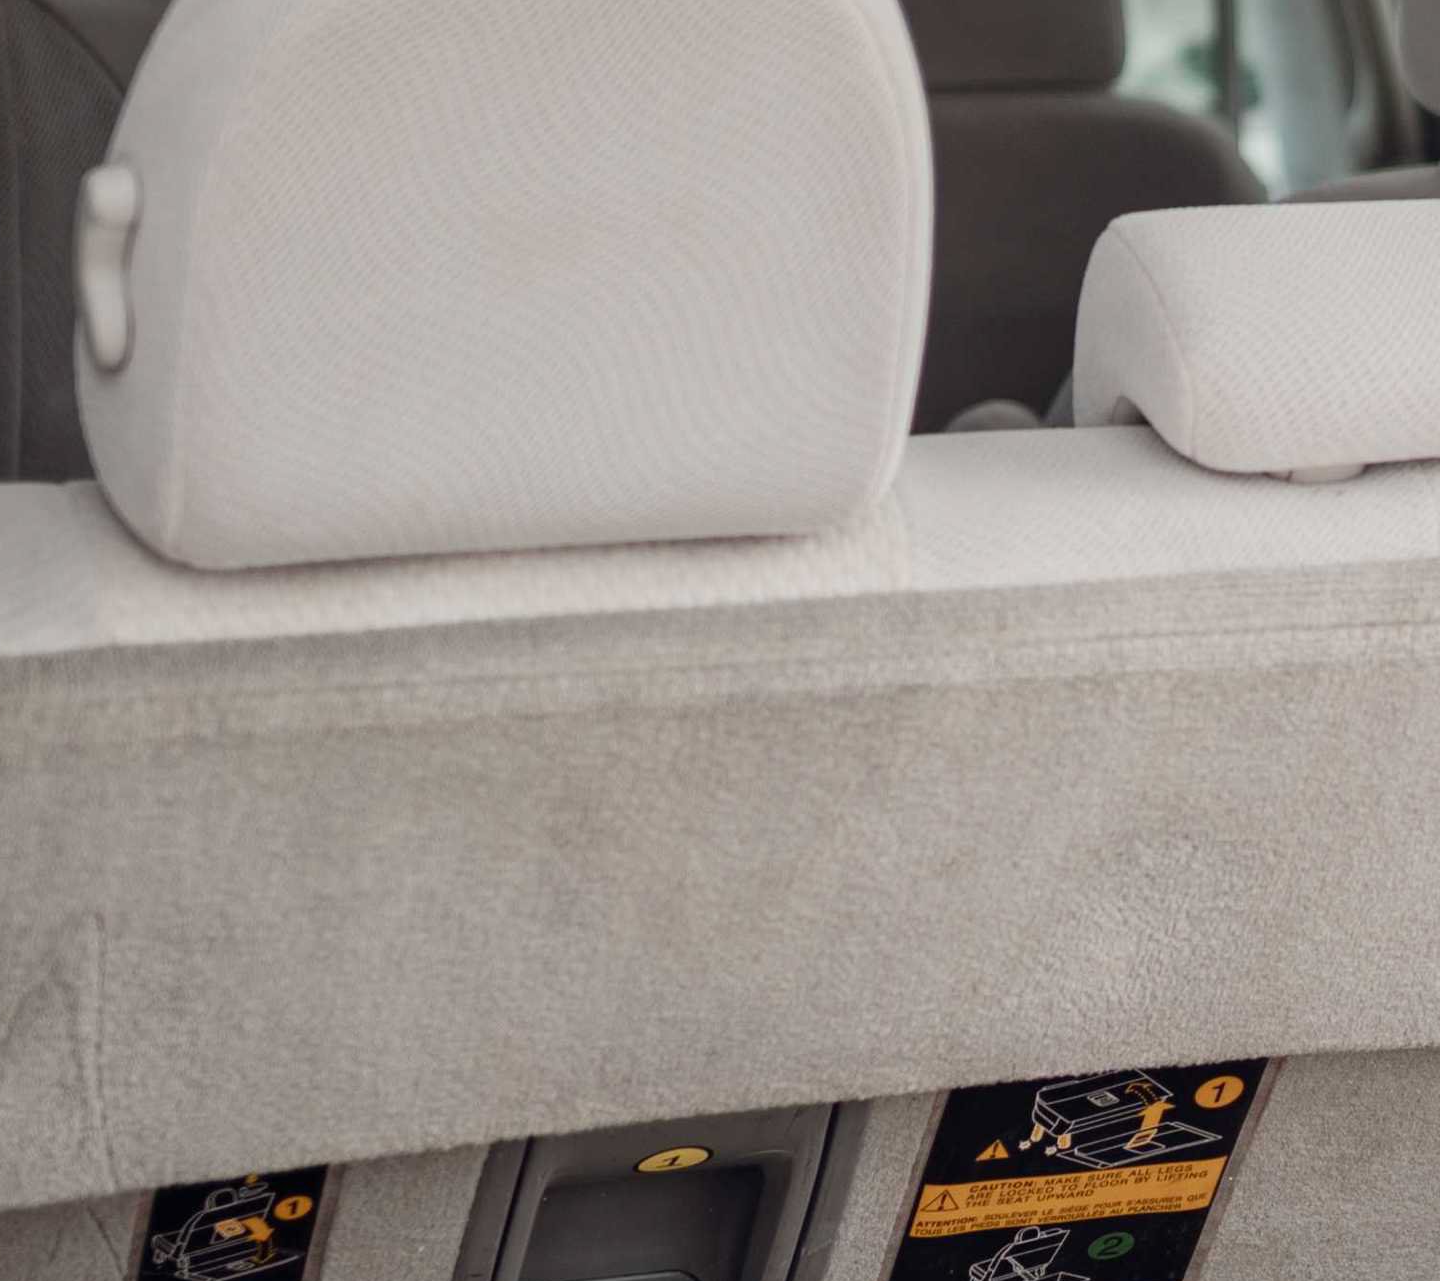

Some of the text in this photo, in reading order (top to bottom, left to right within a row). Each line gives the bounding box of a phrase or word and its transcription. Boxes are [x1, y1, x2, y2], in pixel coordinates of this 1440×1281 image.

[1044, 1175, 1080, 1185] MAKE
[1088, 1171, 1122, 1181] SURE
[1128, 1168, 1150, 1177] ALL
[1157, 1164, 1192, 1174] LEGS
[966, 1170, 1208, 1200] ARE LOCKED TO FLOOR BY LIFTING
[965, 1190, 1094, 1208] THE SEAT UPWARD
[1093, 1201, 1121, 1209] POUR
